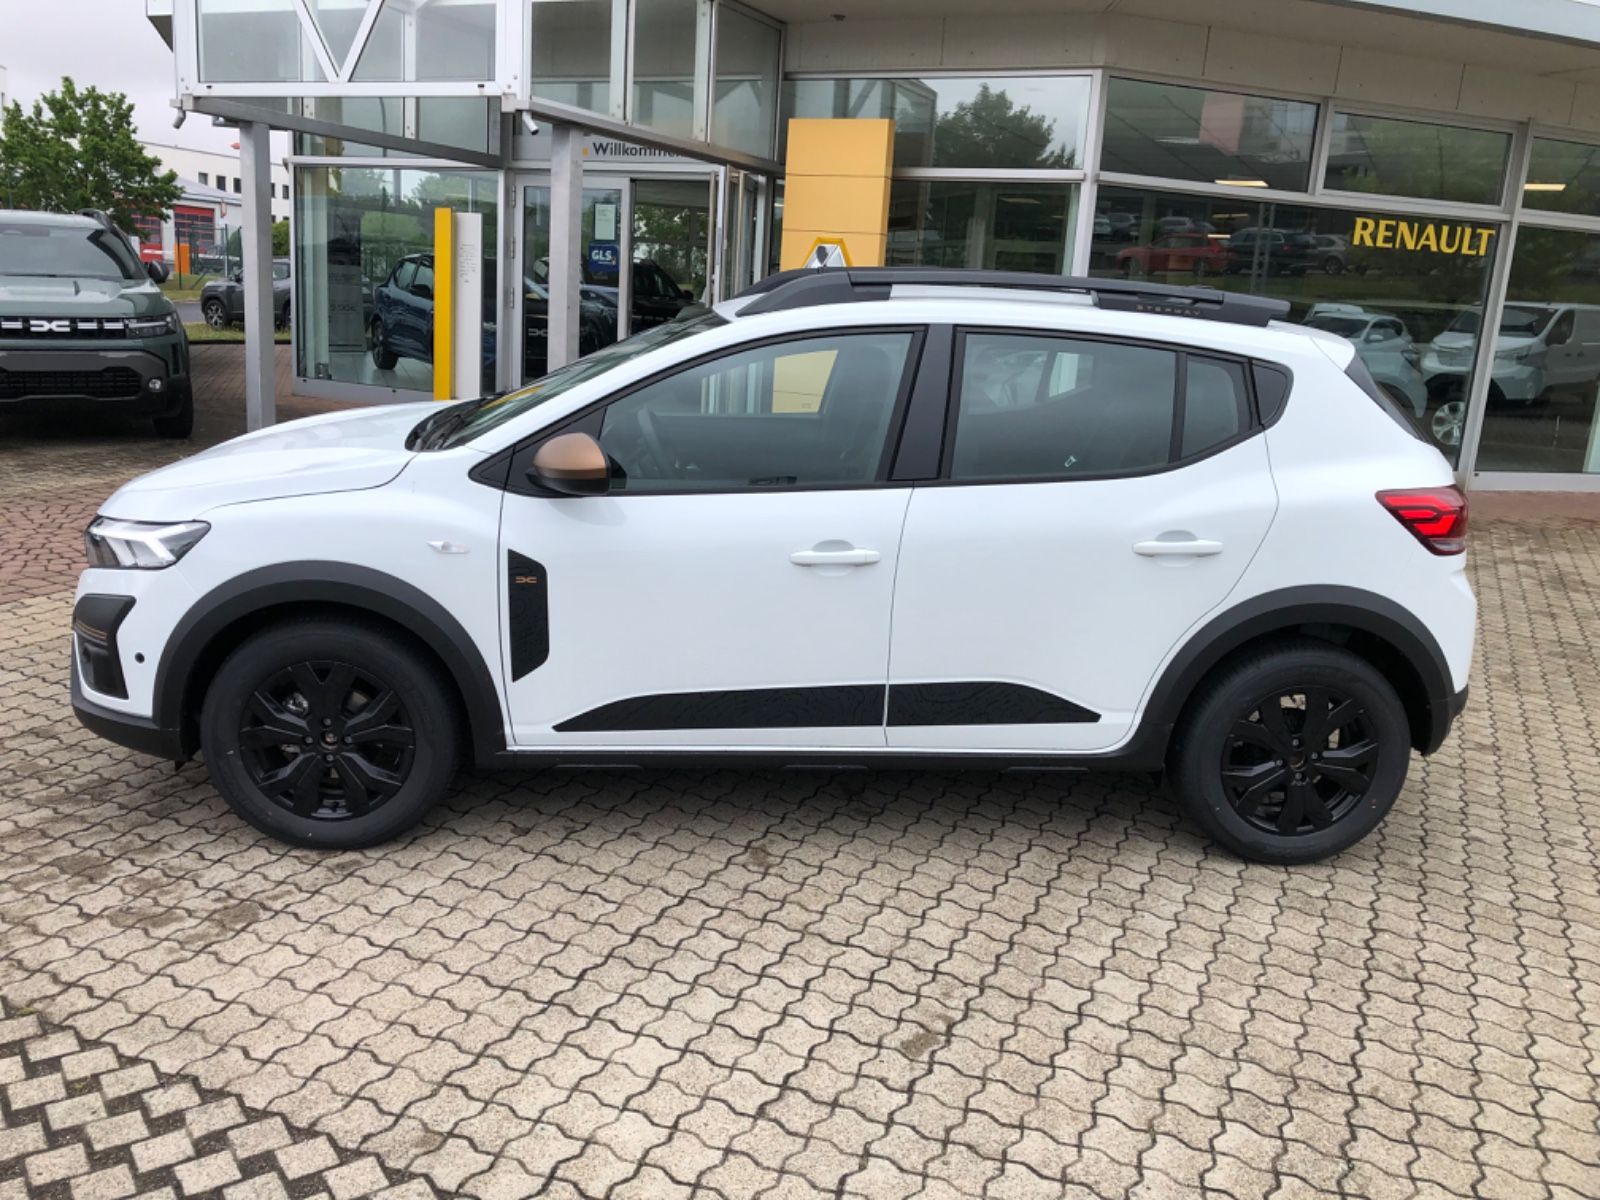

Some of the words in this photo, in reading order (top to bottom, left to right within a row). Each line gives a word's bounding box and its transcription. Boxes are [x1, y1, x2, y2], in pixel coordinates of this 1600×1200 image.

[1352, 216, 1496, 257] RENAULT
[591, 249, 613, 261] GLS
[1136, 304, 1200, 316] STEPWAY
